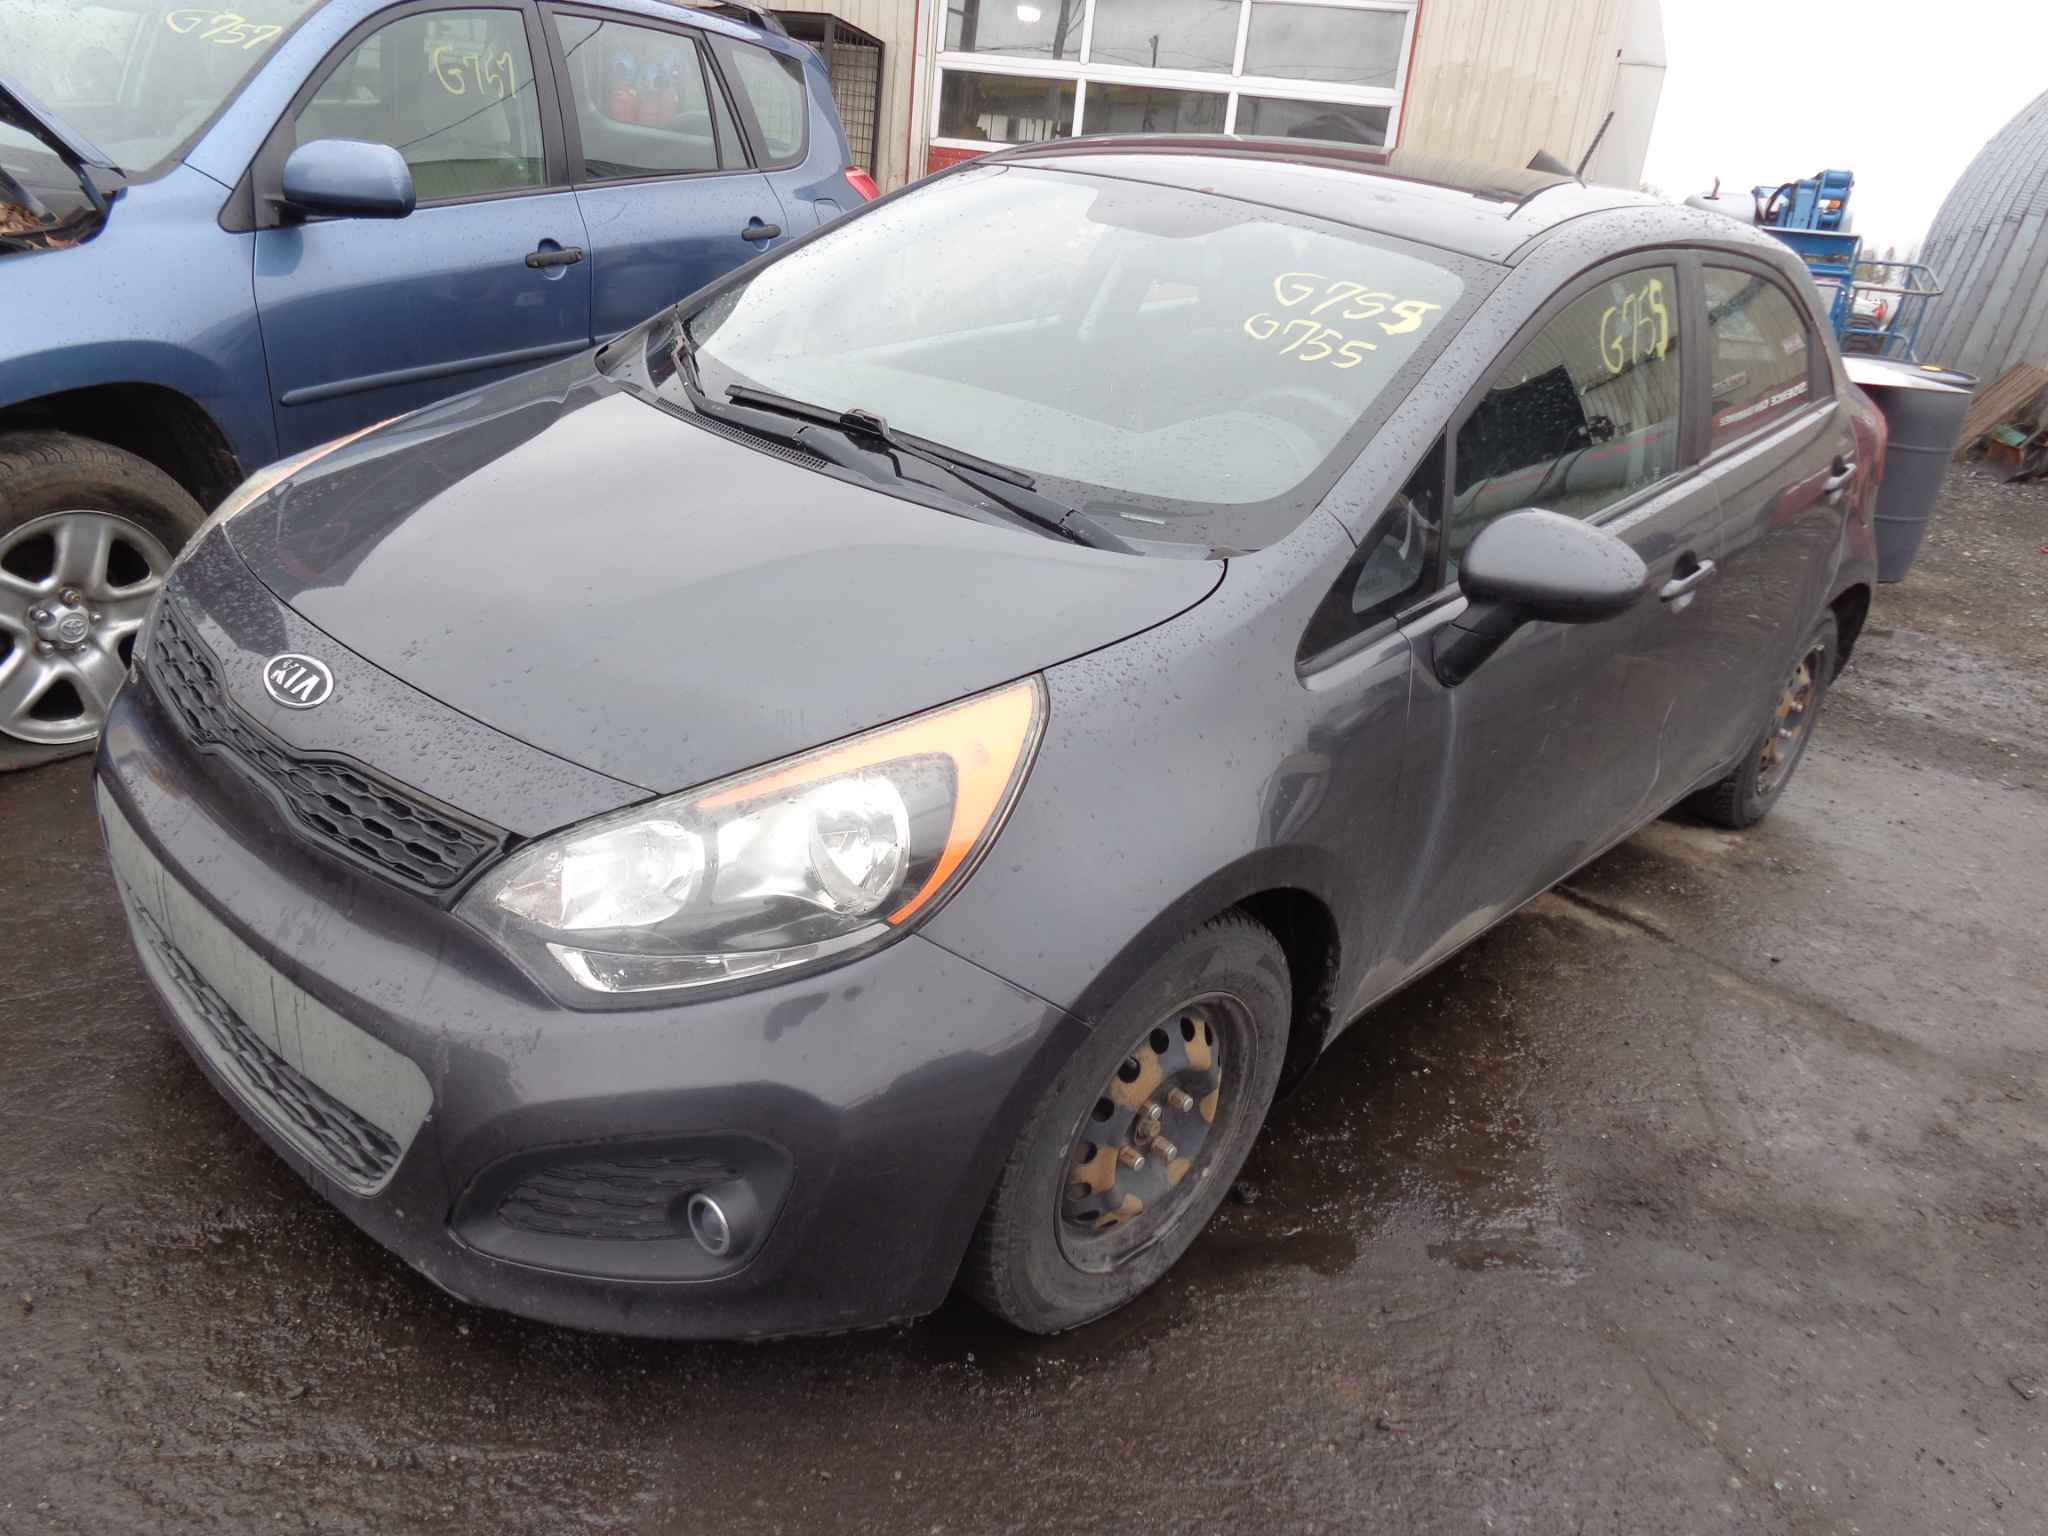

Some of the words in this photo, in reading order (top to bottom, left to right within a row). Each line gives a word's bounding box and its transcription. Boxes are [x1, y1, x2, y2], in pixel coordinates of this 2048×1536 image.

[166, 8, 282, 50] G757
[433, 46, 517, 98] G757
[1244, 312, 1377, 369] G755
[269, 659, 321, 702] KIA
